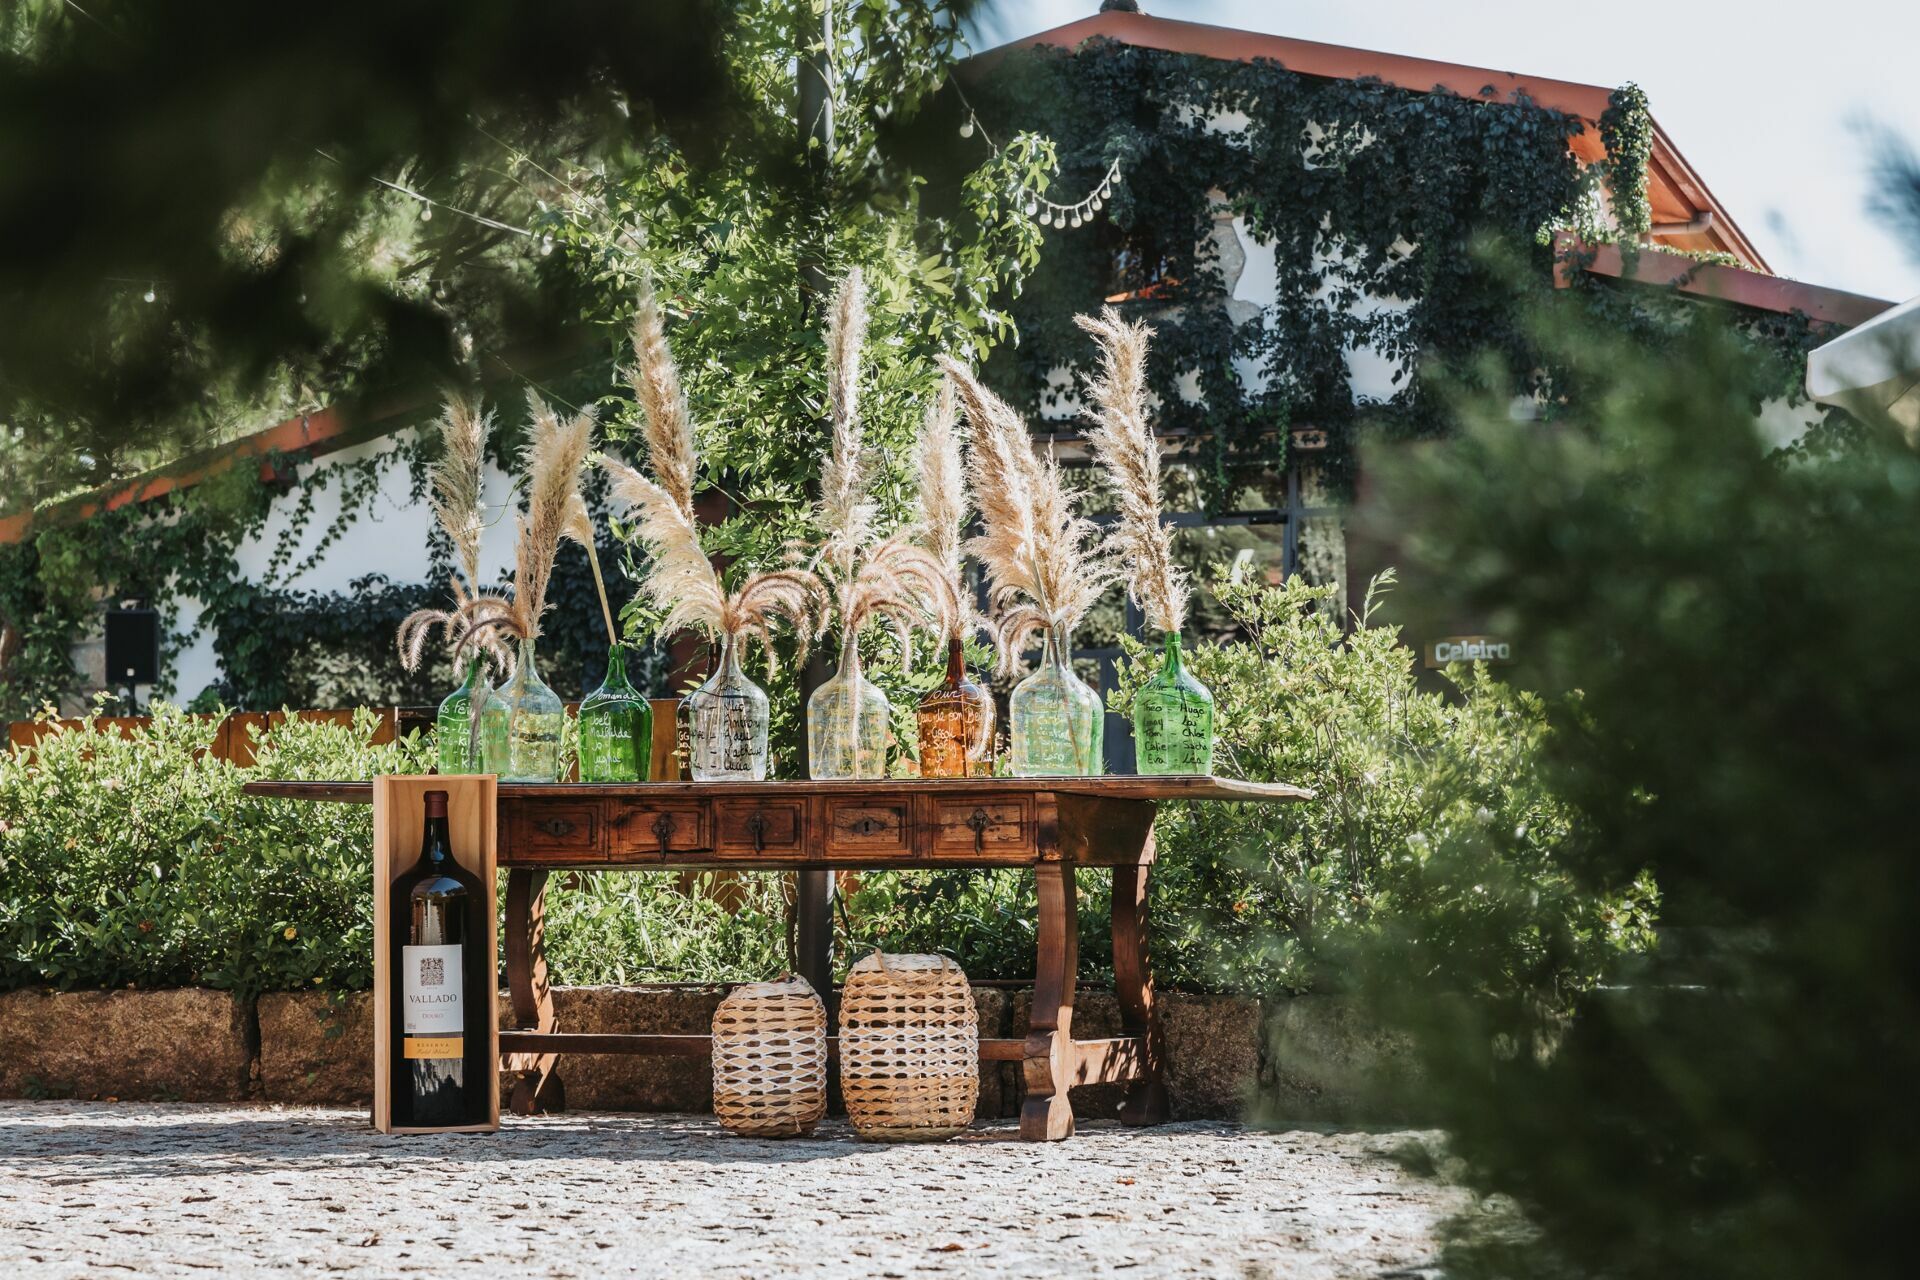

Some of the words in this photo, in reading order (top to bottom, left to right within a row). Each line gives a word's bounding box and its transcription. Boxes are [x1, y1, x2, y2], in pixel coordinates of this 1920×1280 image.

[1435, 640, 1510, 662] Celeiro
[1180, 703, 1205, 717] Hugo
[1182, 728, 1206, 739] Chloé
[409, 993, 457, 1003] VALLADO
